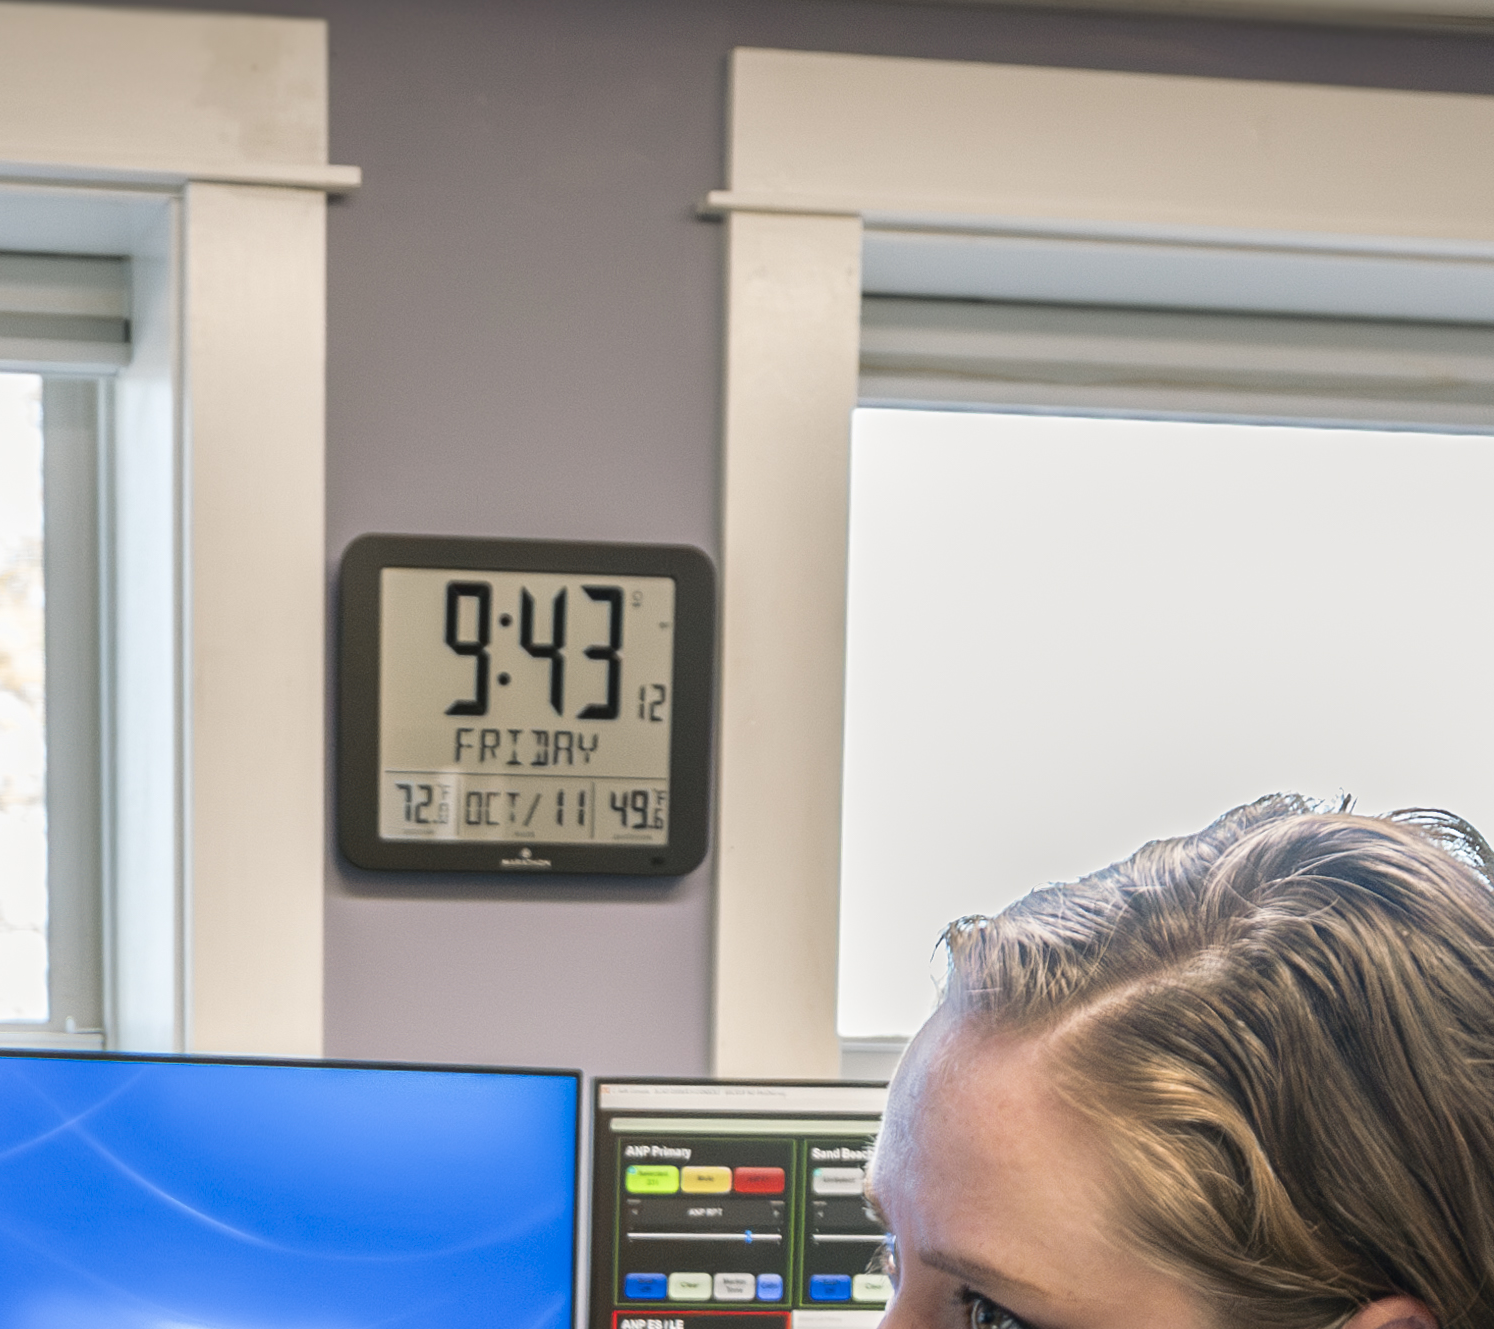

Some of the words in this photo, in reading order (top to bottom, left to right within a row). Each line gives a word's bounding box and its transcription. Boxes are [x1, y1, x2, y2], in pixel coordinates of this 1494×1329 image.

[444, 579, 624, 721] 9:43
[454, 728, 599, 766] FRIDAY
[624, 1145, 652, 1158] ANP
[653, 1146, 692, 1161] Primary
[811, 1147, 840, 1159] Sand
